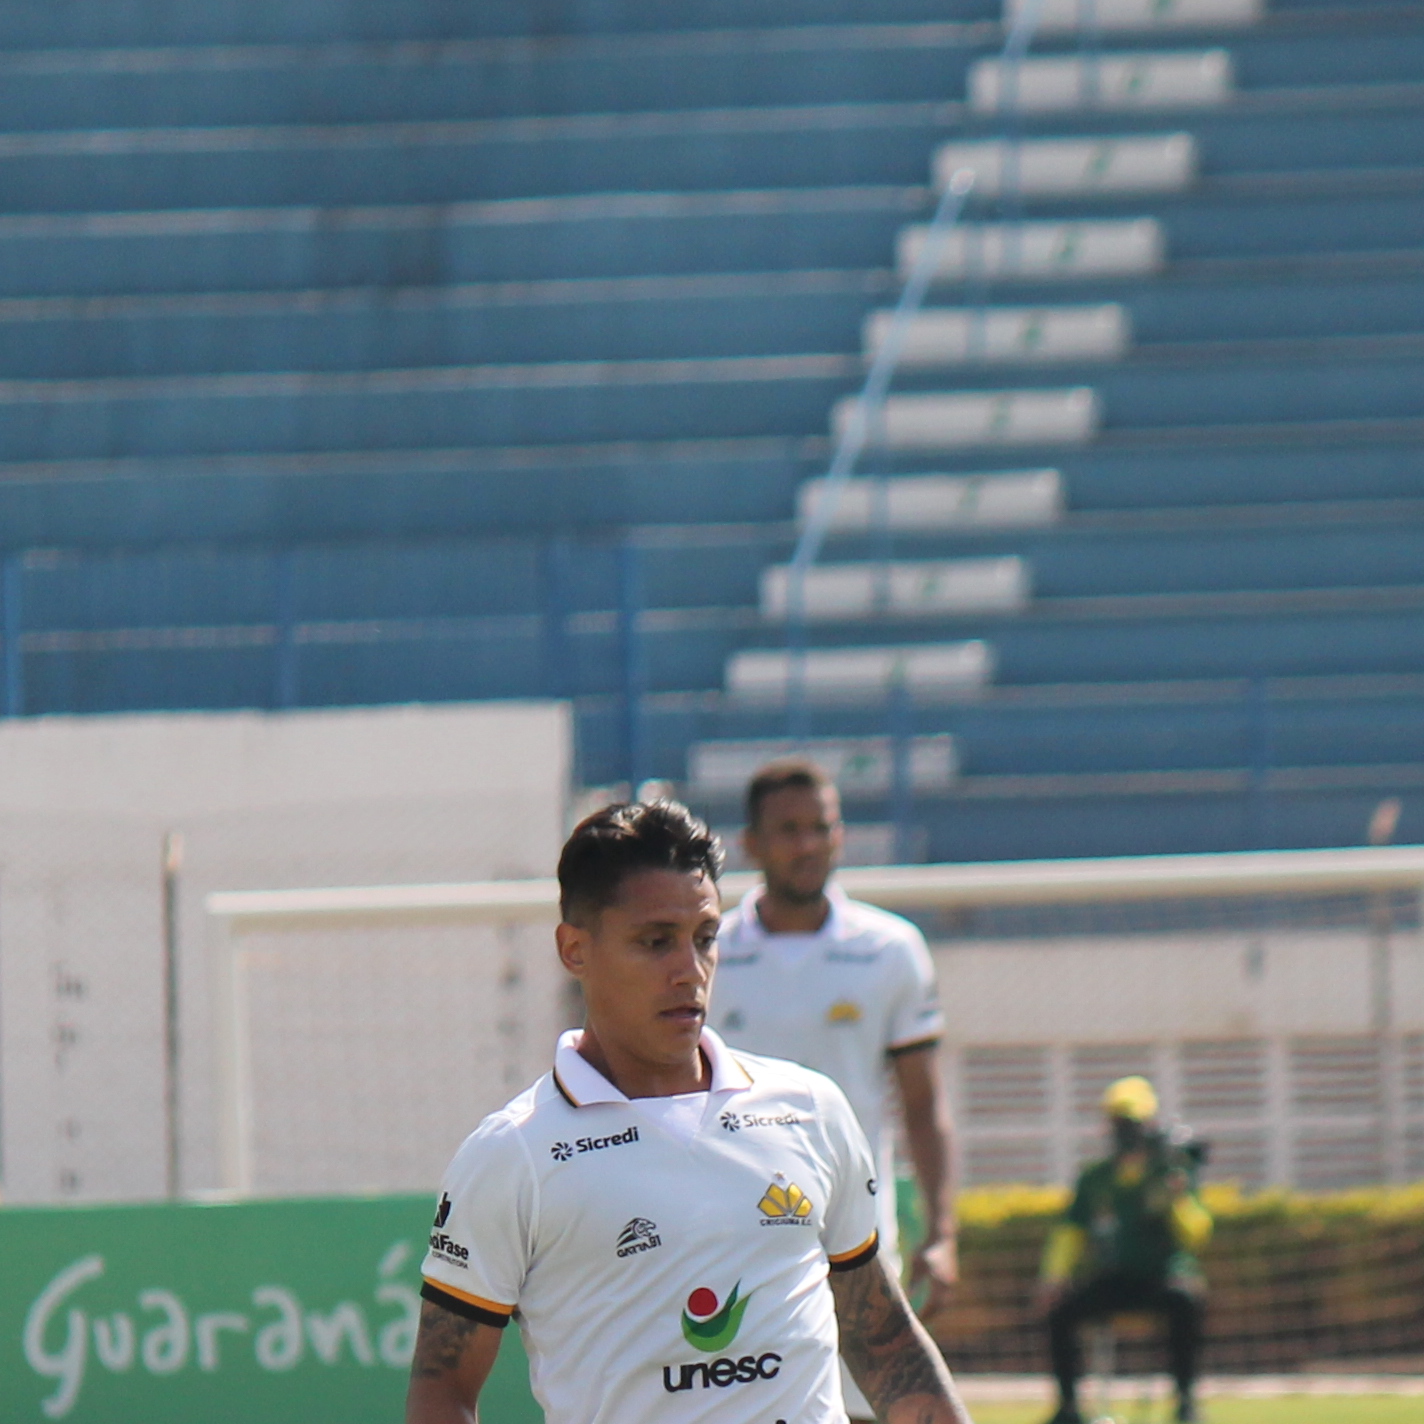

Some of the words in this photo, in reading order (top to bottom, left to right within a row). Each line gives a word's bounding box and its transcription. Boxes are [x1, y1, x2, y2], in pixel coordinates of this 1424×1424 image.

[743, 1112, 800, 1129] Sicredi
[575, 1126, 639, 1153] Sicredi
[23, 1242, 422, 1420] Guaraná
[663, 1352, 782, 1393] unesc
